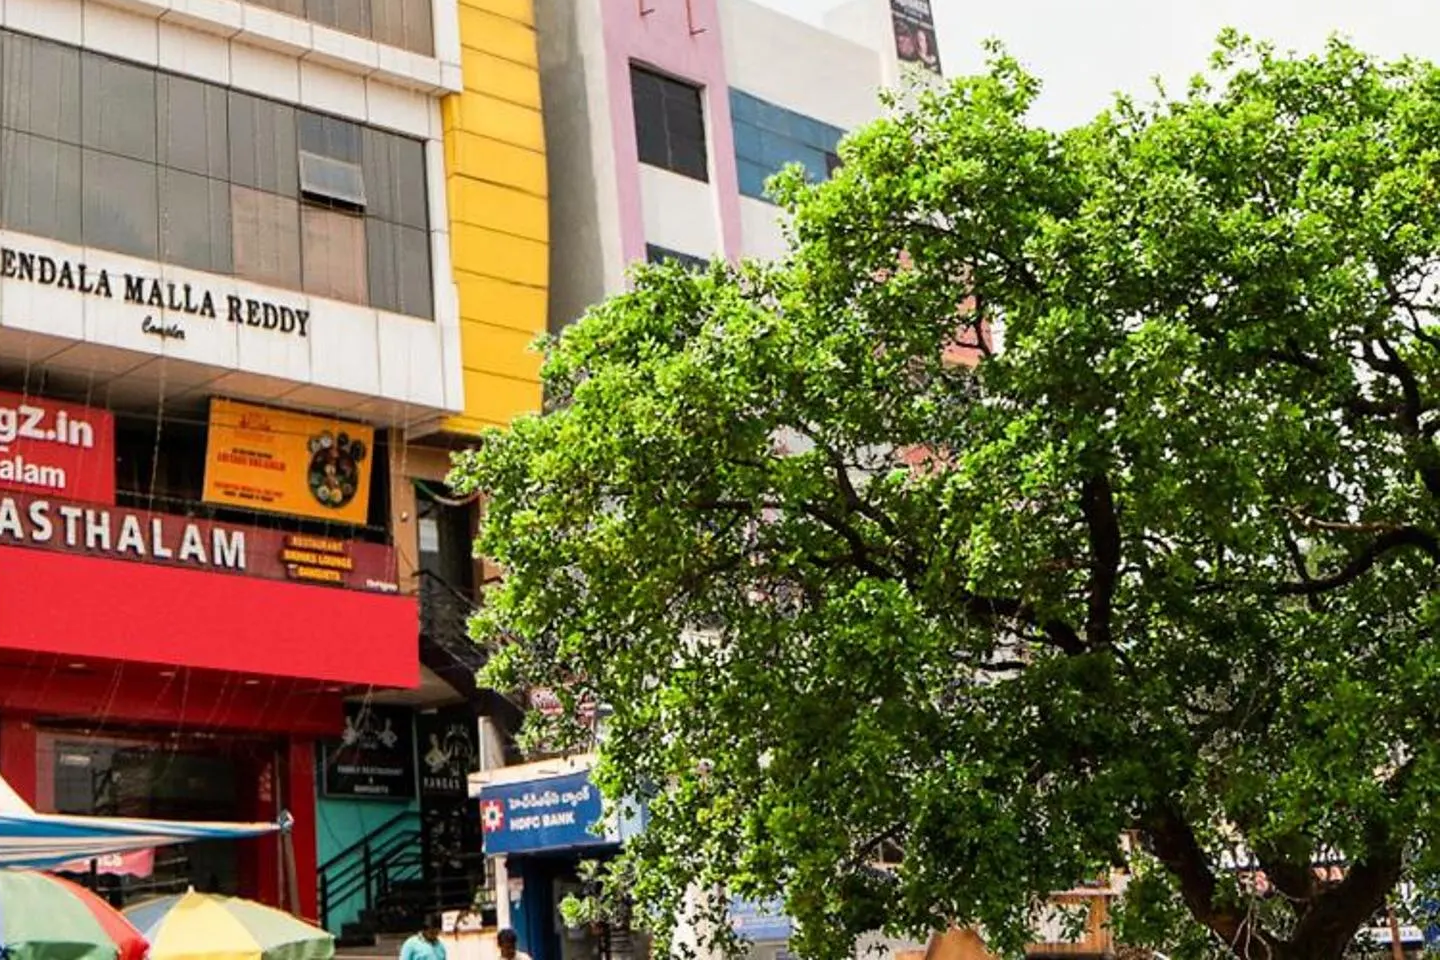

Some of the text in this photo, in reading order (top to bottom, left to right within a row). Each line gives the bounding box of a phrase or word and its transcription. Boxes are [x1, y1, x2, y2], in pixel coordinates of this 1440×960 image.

[0, 247, 310, 338] ENDALA MALLA REDDY
[541, 811, 576, 827] BANK
